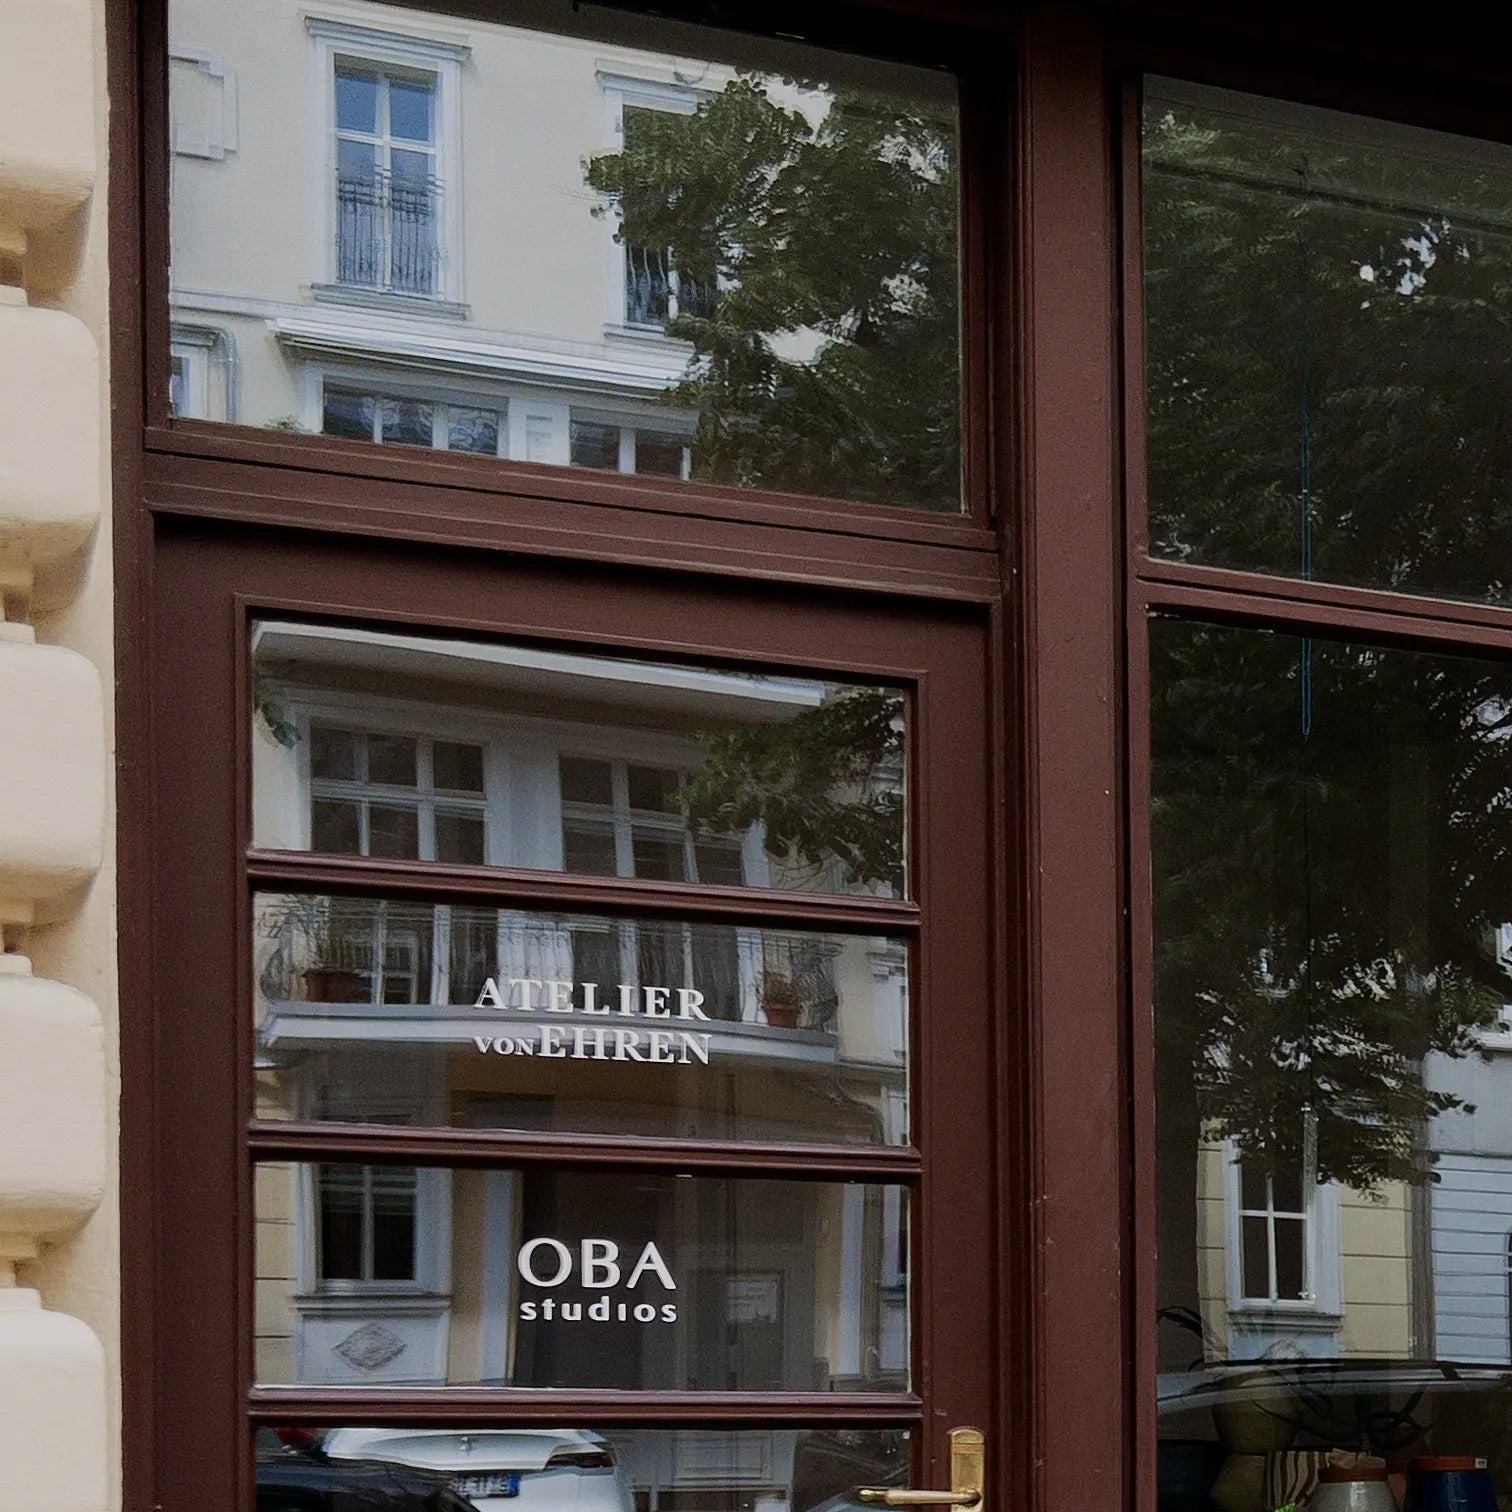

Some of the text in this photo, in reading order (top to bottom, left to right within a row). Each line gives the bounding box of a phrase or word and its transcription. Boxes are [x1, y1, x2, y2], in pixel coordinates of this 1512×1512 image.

[473, 977, 712, 1021] ATELIER
[537, 1024, 713, 1065] EHREN
[517, 1237, 677, 1289] OBA
[519, 1296, 678, 1323] studios
